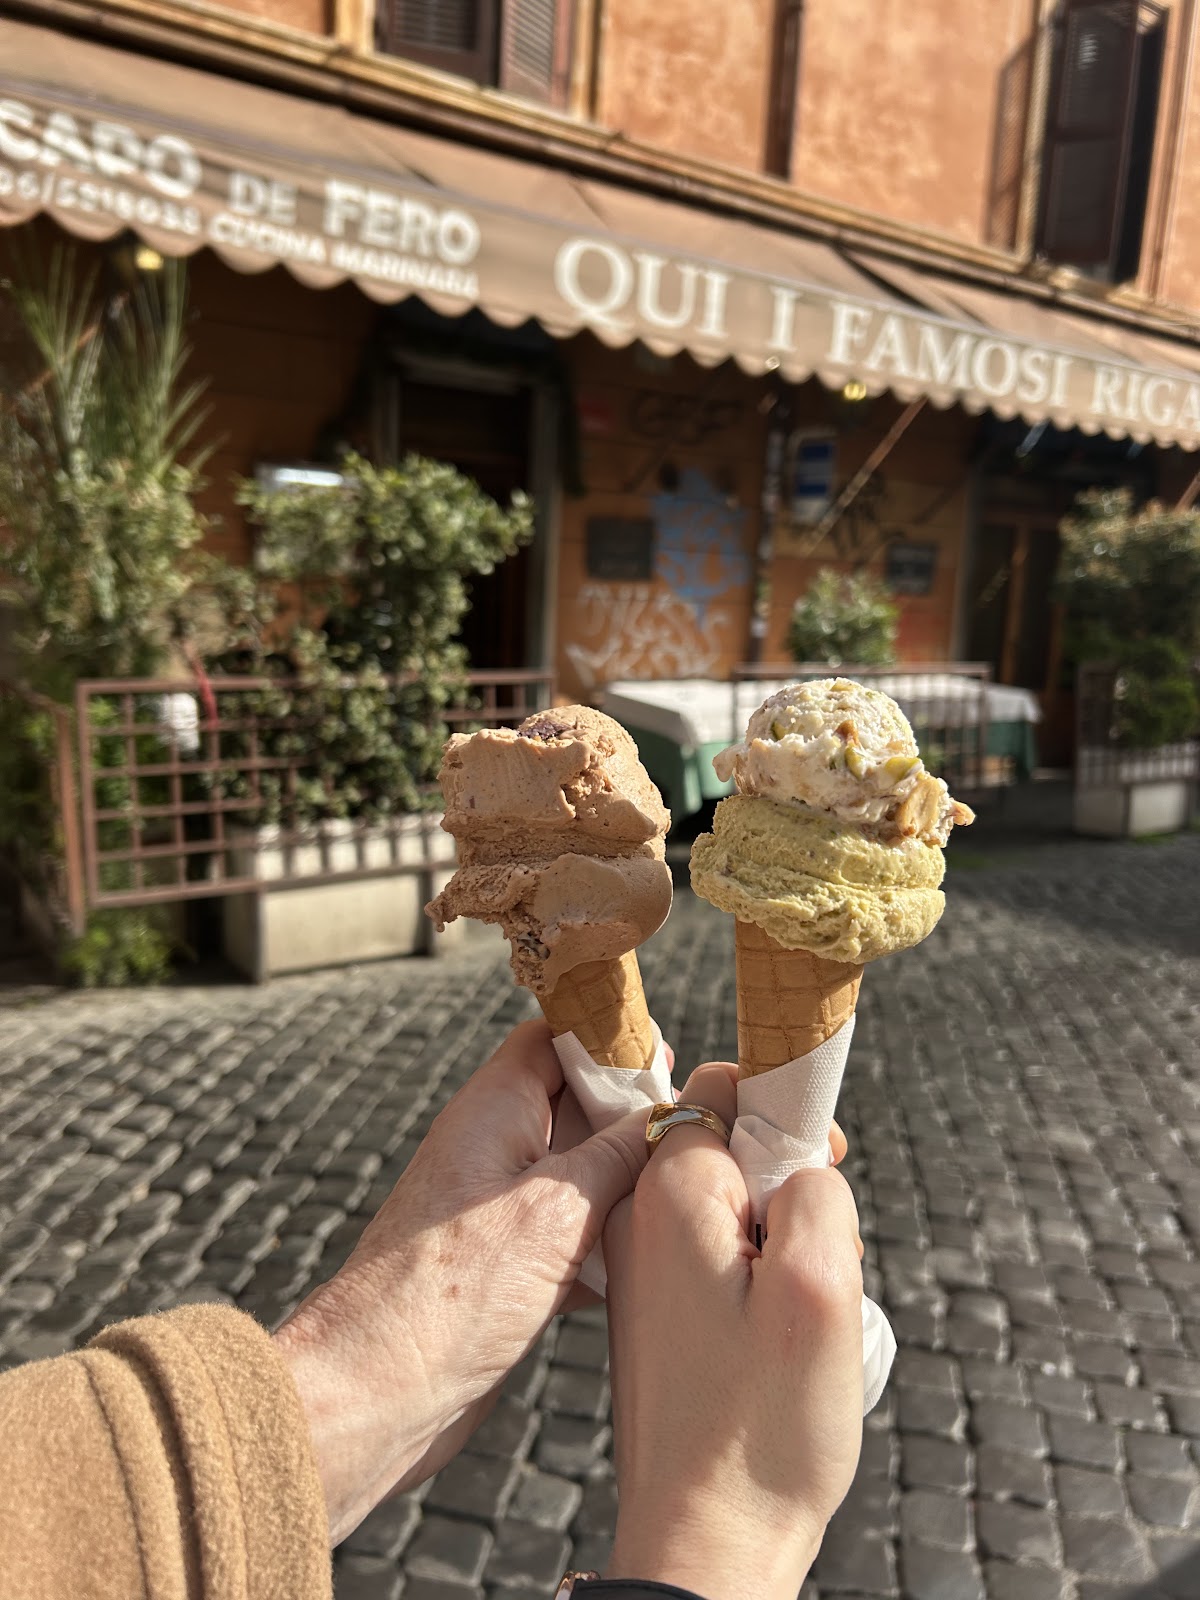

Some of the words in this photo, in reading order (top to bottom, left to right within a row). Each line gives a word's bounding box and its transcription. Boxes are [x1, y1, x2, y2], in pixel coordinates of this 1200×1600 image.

[230, 169, 297, 226] DE
[323, 179, 481, 266] FERO
[553, 237, 732, 338] QUI
[769, 285, 803, 351] I
[828, 302, 1074, 408] FAMOSI
